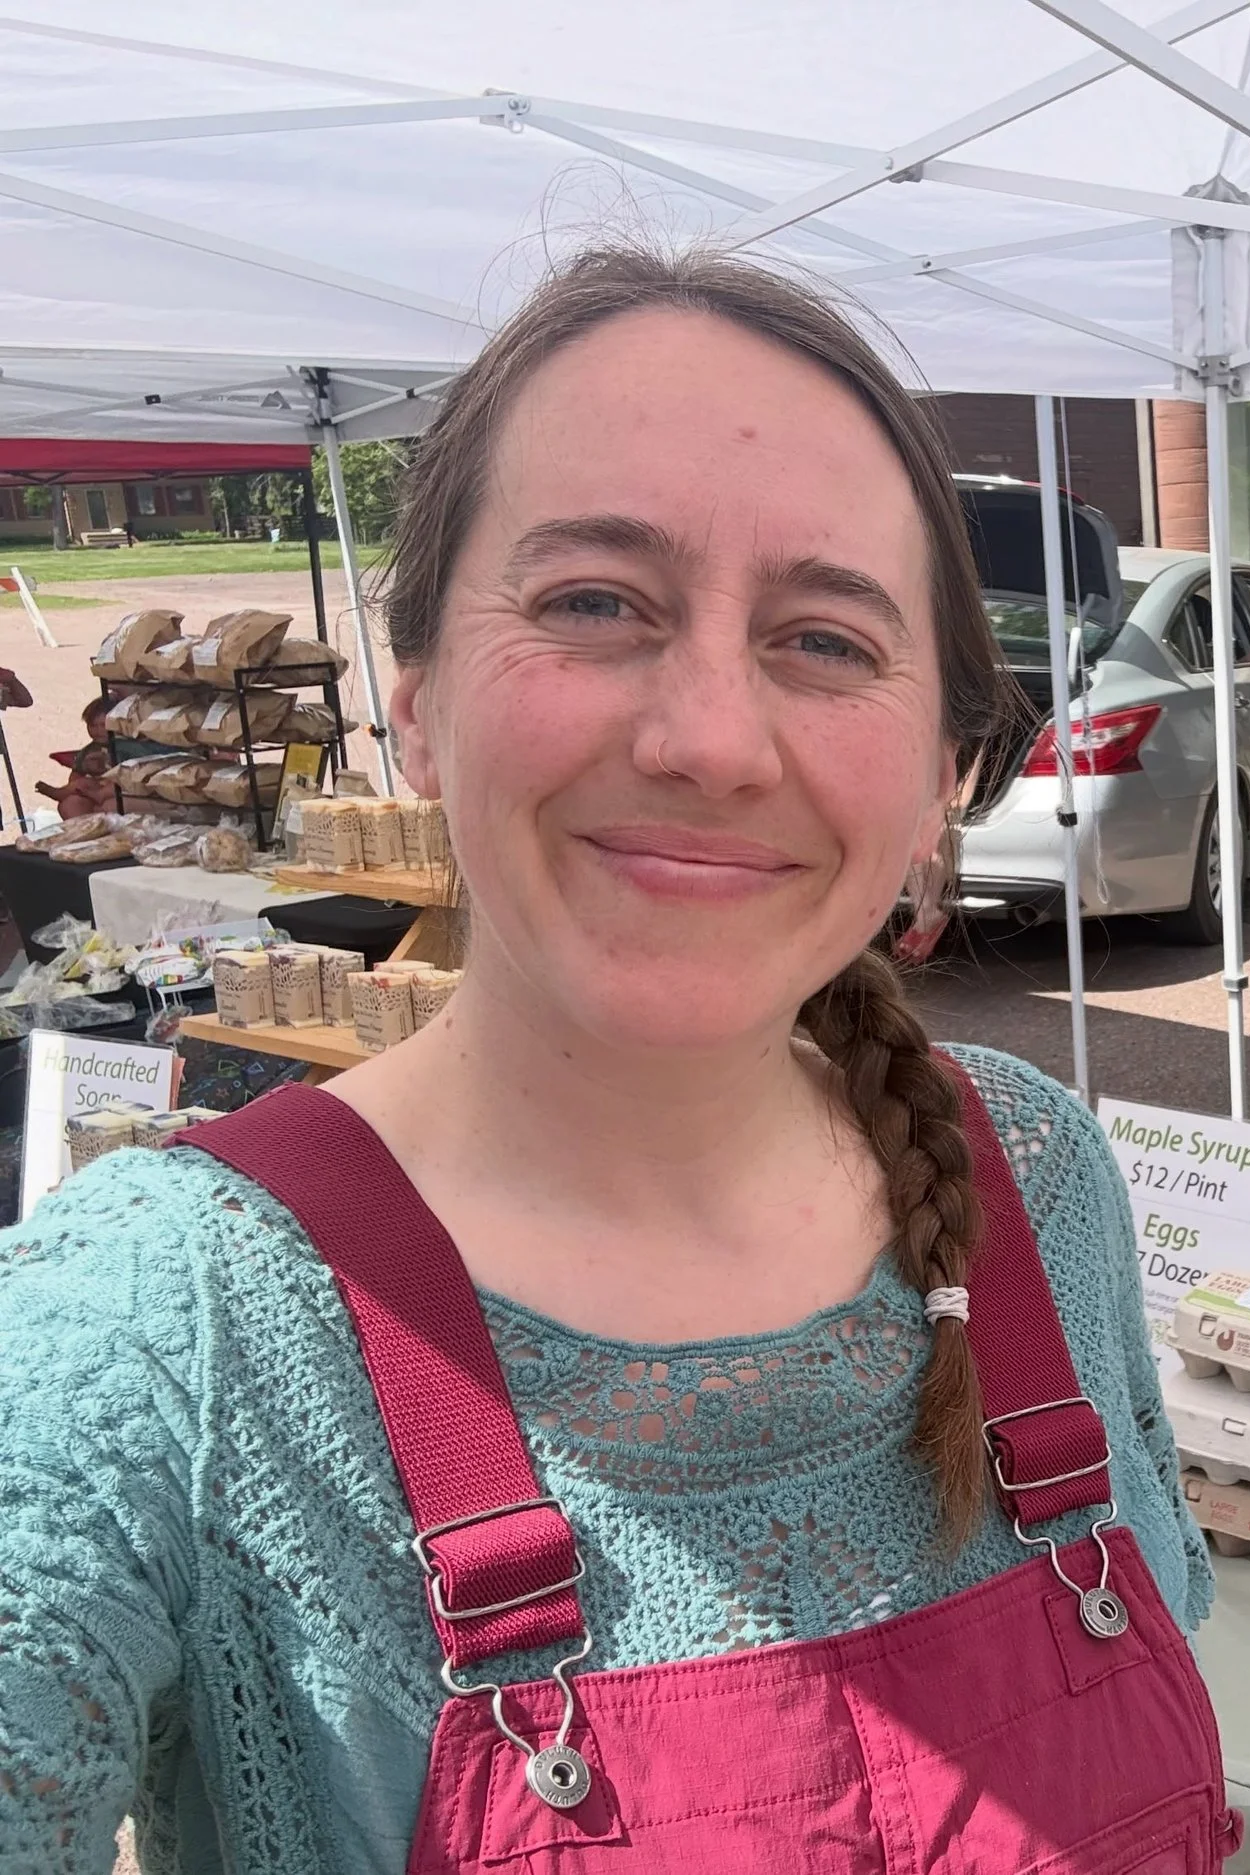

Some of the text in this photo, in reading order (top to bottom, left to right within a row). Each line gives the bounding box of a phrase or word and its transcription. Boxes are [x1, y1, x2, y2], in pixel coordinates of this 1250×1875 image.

[44, 1047, 161, 1084] Handcrafted
[1109, 1116, 1183, 1153] Maple
[1185, 1171, 1228, 1203] Pint
[1143, 1213, 1200, 1251] Eggs
